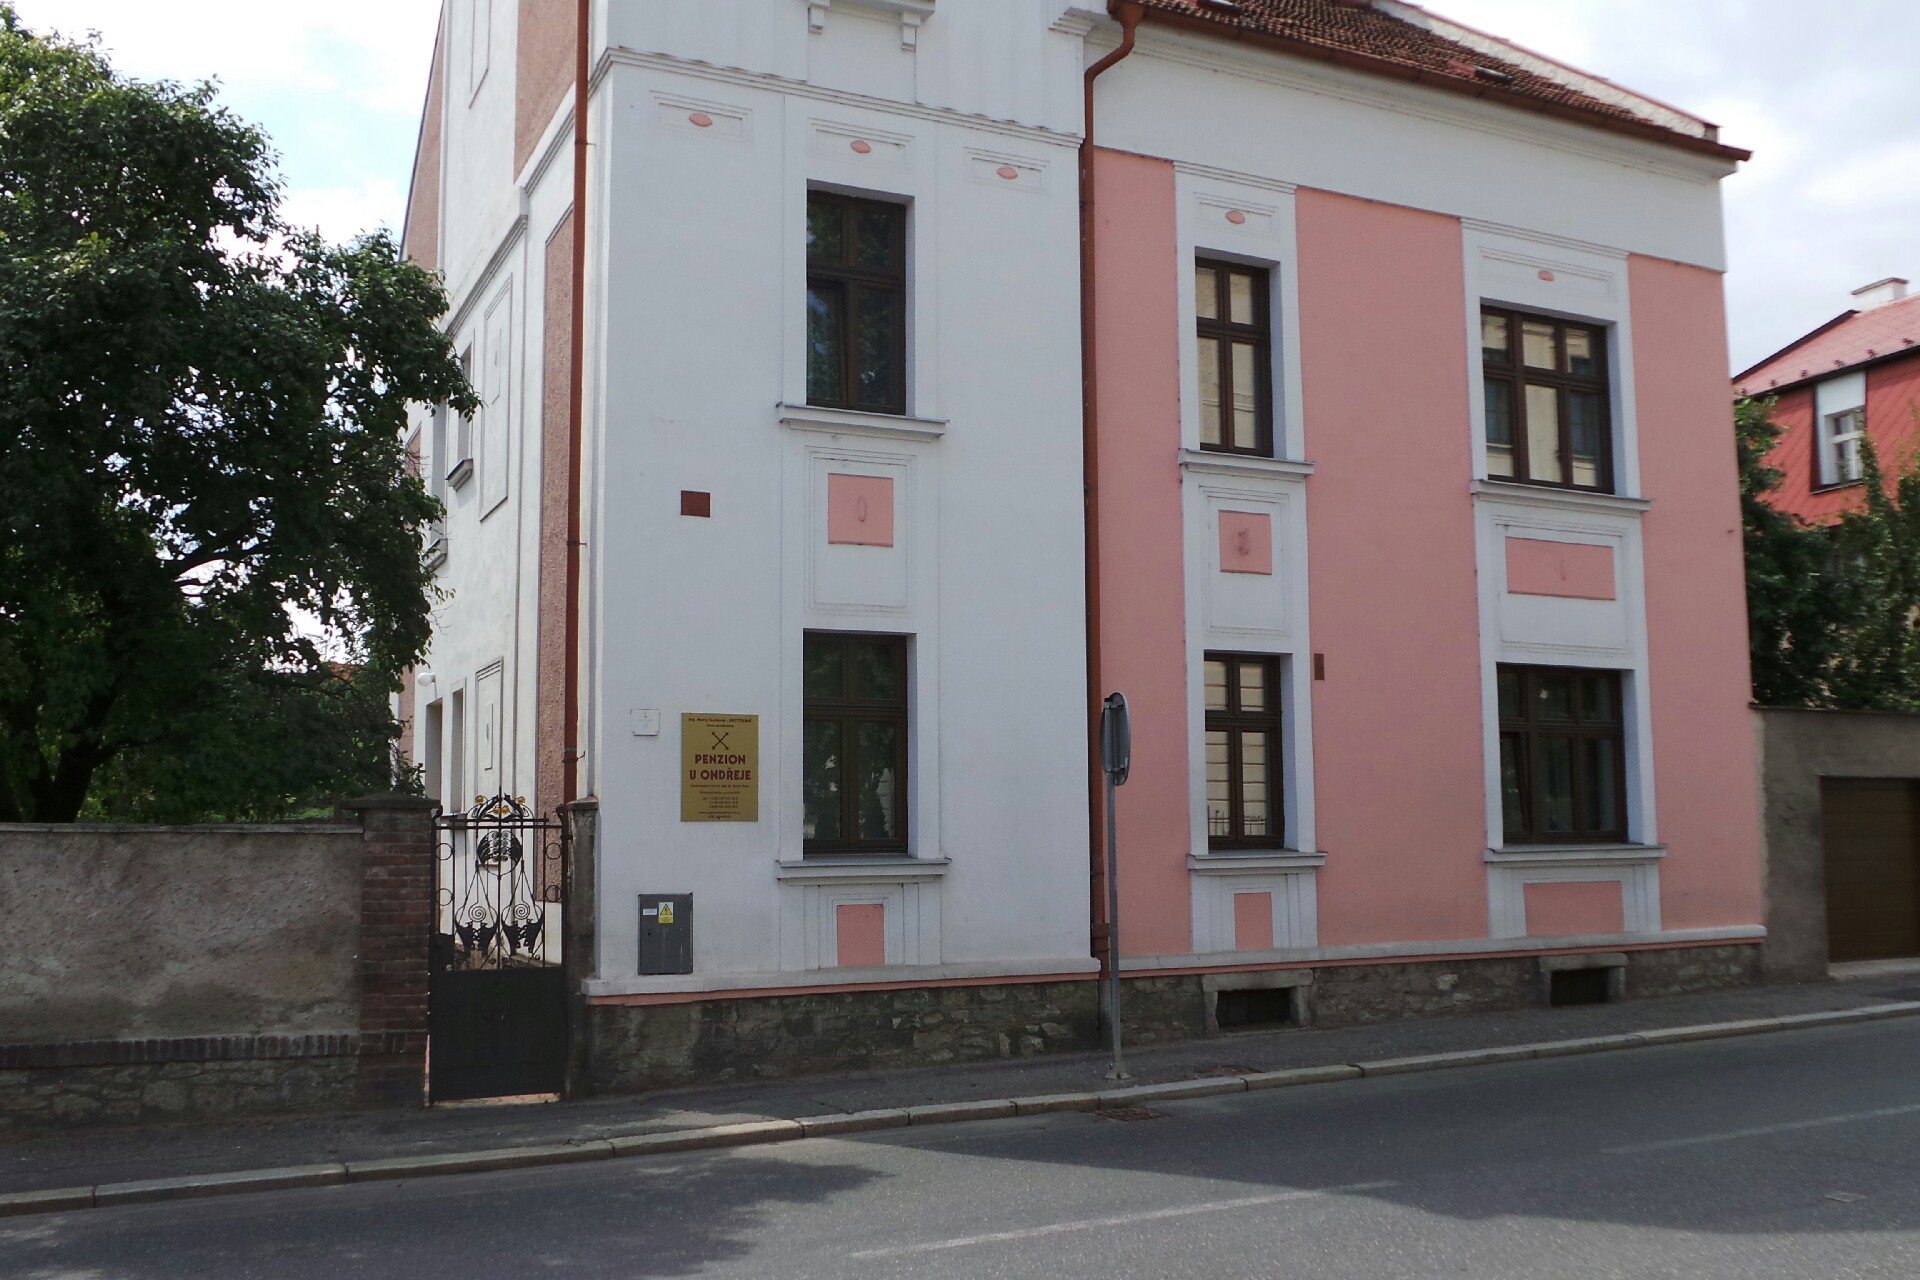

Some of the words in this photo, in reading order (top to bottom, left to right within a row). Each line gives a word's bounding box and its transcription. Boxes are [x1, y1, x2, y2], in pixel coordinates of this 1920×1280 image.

[695, 754, 746, 765] PENZION
[689, 769, 697, 780] U
[700, 767, 752, 780] ONDŘEJE
